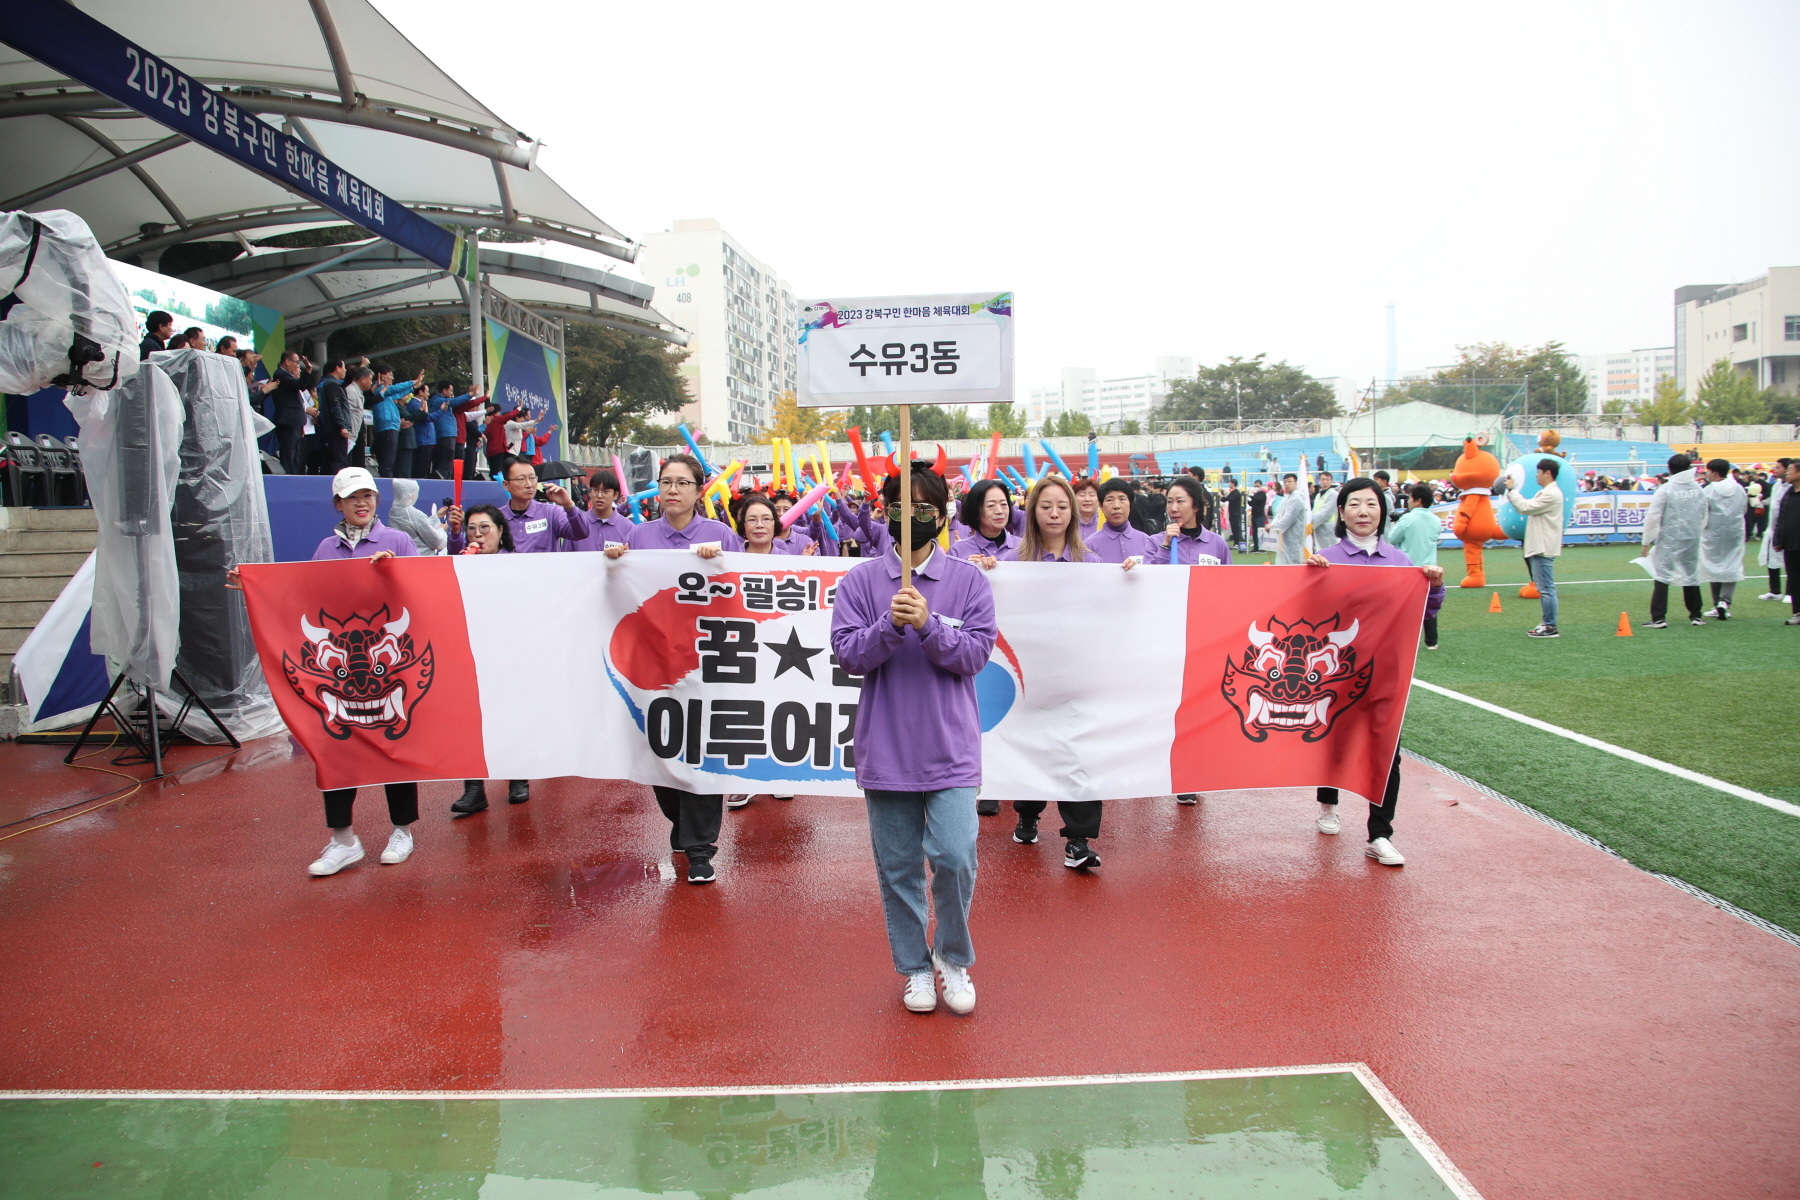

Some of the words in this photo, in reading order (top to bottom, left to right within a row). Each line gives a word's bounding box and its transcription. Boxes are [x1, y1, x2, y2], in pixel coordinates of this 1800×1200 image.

[126, 46, 191, 117] 2023
[201, 88, 278, 168] 강북구민
[284, 140, 330, 197] 한마음
[336, 170, 385, 226] 체육대회
[666, 276, 685, 287] LH
[676, 292, 692, 304] 408
[837, 309, 863, 320] 2023
[864, 307, 901, 320] 강북구민
[903, 306, 931, 318] 한마음
[933, 304, 971, 317] 체육대회
[848, 340, 961, 377] 수유3동
[1673, 489, 1700, 499] STAFF
[1578, 509, 1613, 525] 교통의
[742, 577, 818, 611] 필승!
